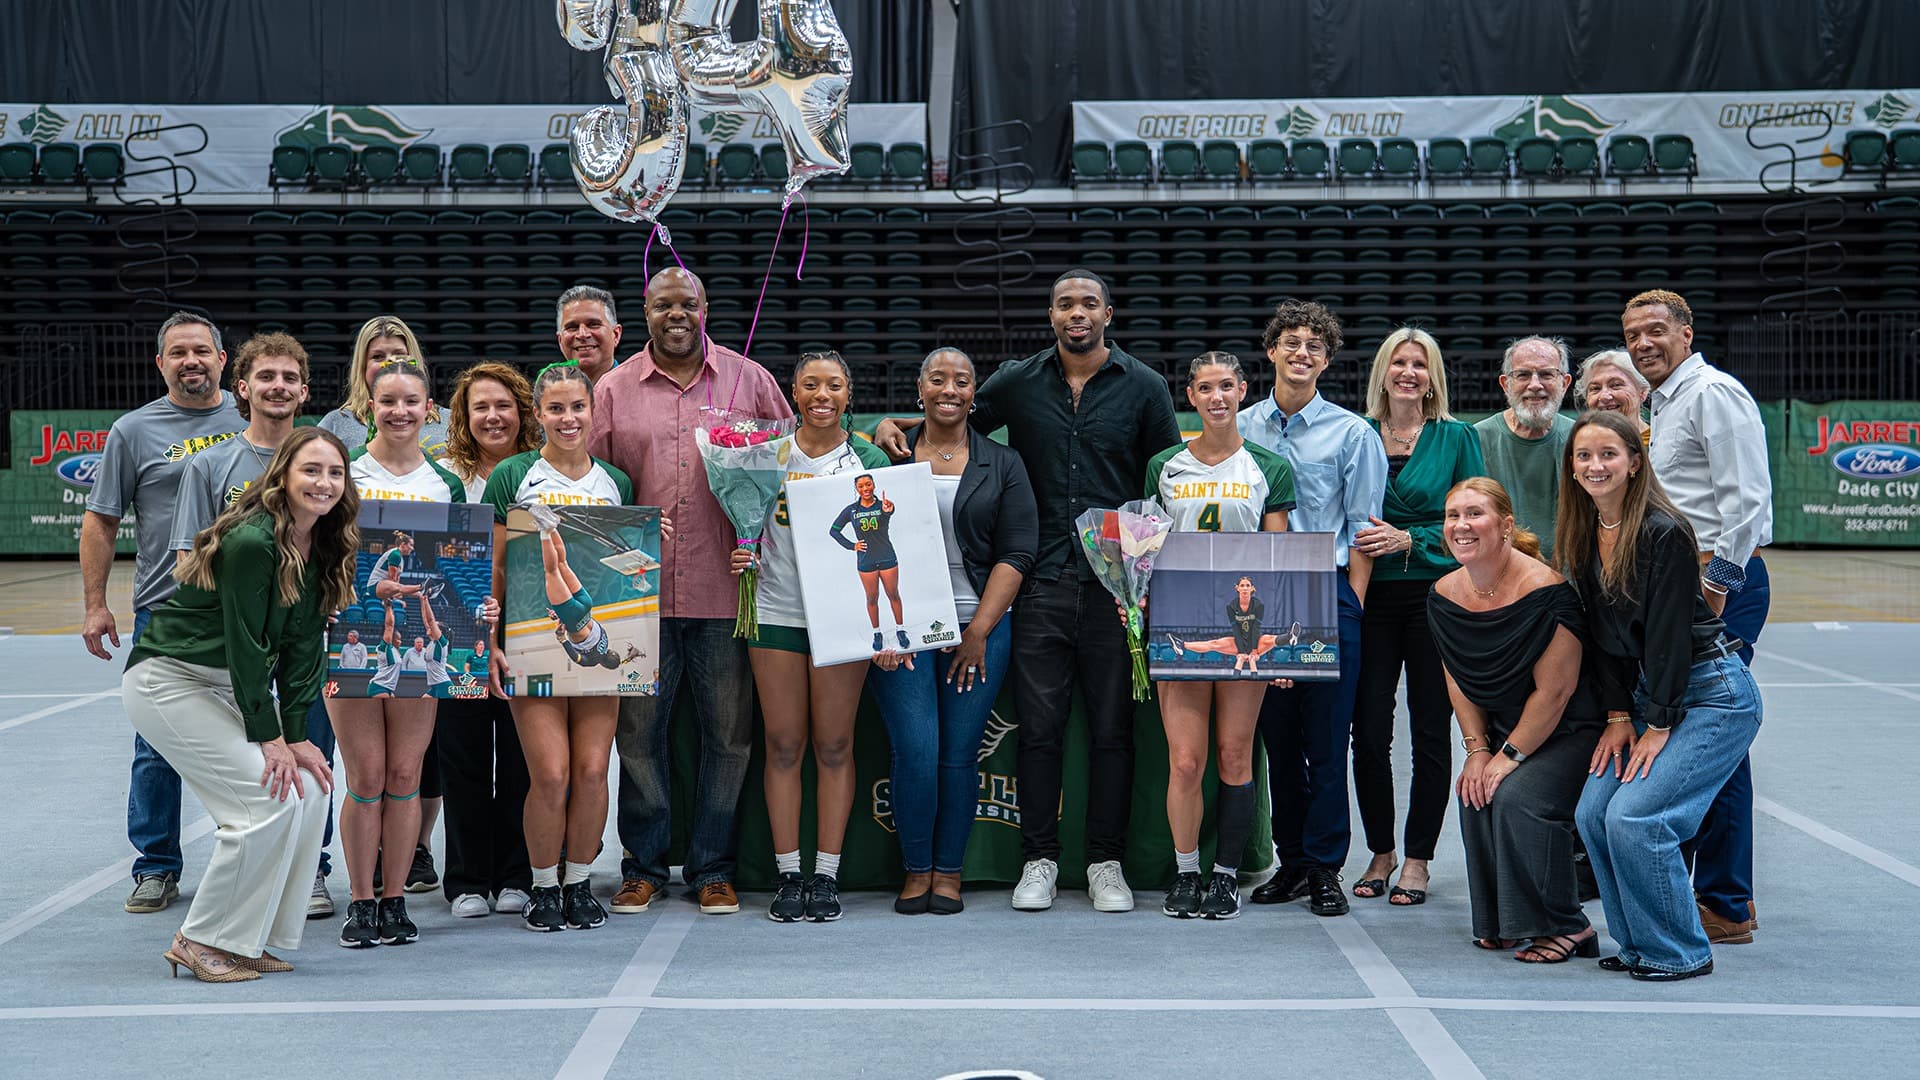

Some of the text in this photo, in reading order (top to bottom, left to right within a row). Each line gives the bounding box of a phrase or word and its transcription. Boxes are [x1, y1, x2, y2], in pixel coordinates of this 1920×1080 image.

[74, 114, 161, 140] ALL IN
[1137, 114, 1267, 139] ONE PRIDE
[1324, 112, 1404, 137] ALL IN
[1719, 101, 1855, 128] ONE PRIDE
[1850, 448, 1908, 473] Ford
[1173, 482, 1250, 499] SAINT LEO
[1838, 480, 1919, 499] Dade City
[1198, 502, 1222, 532] 4
[1802, 504, 1920, 516] www.JarrettFordDadeCi
[860, 516, 878, 532] 34
